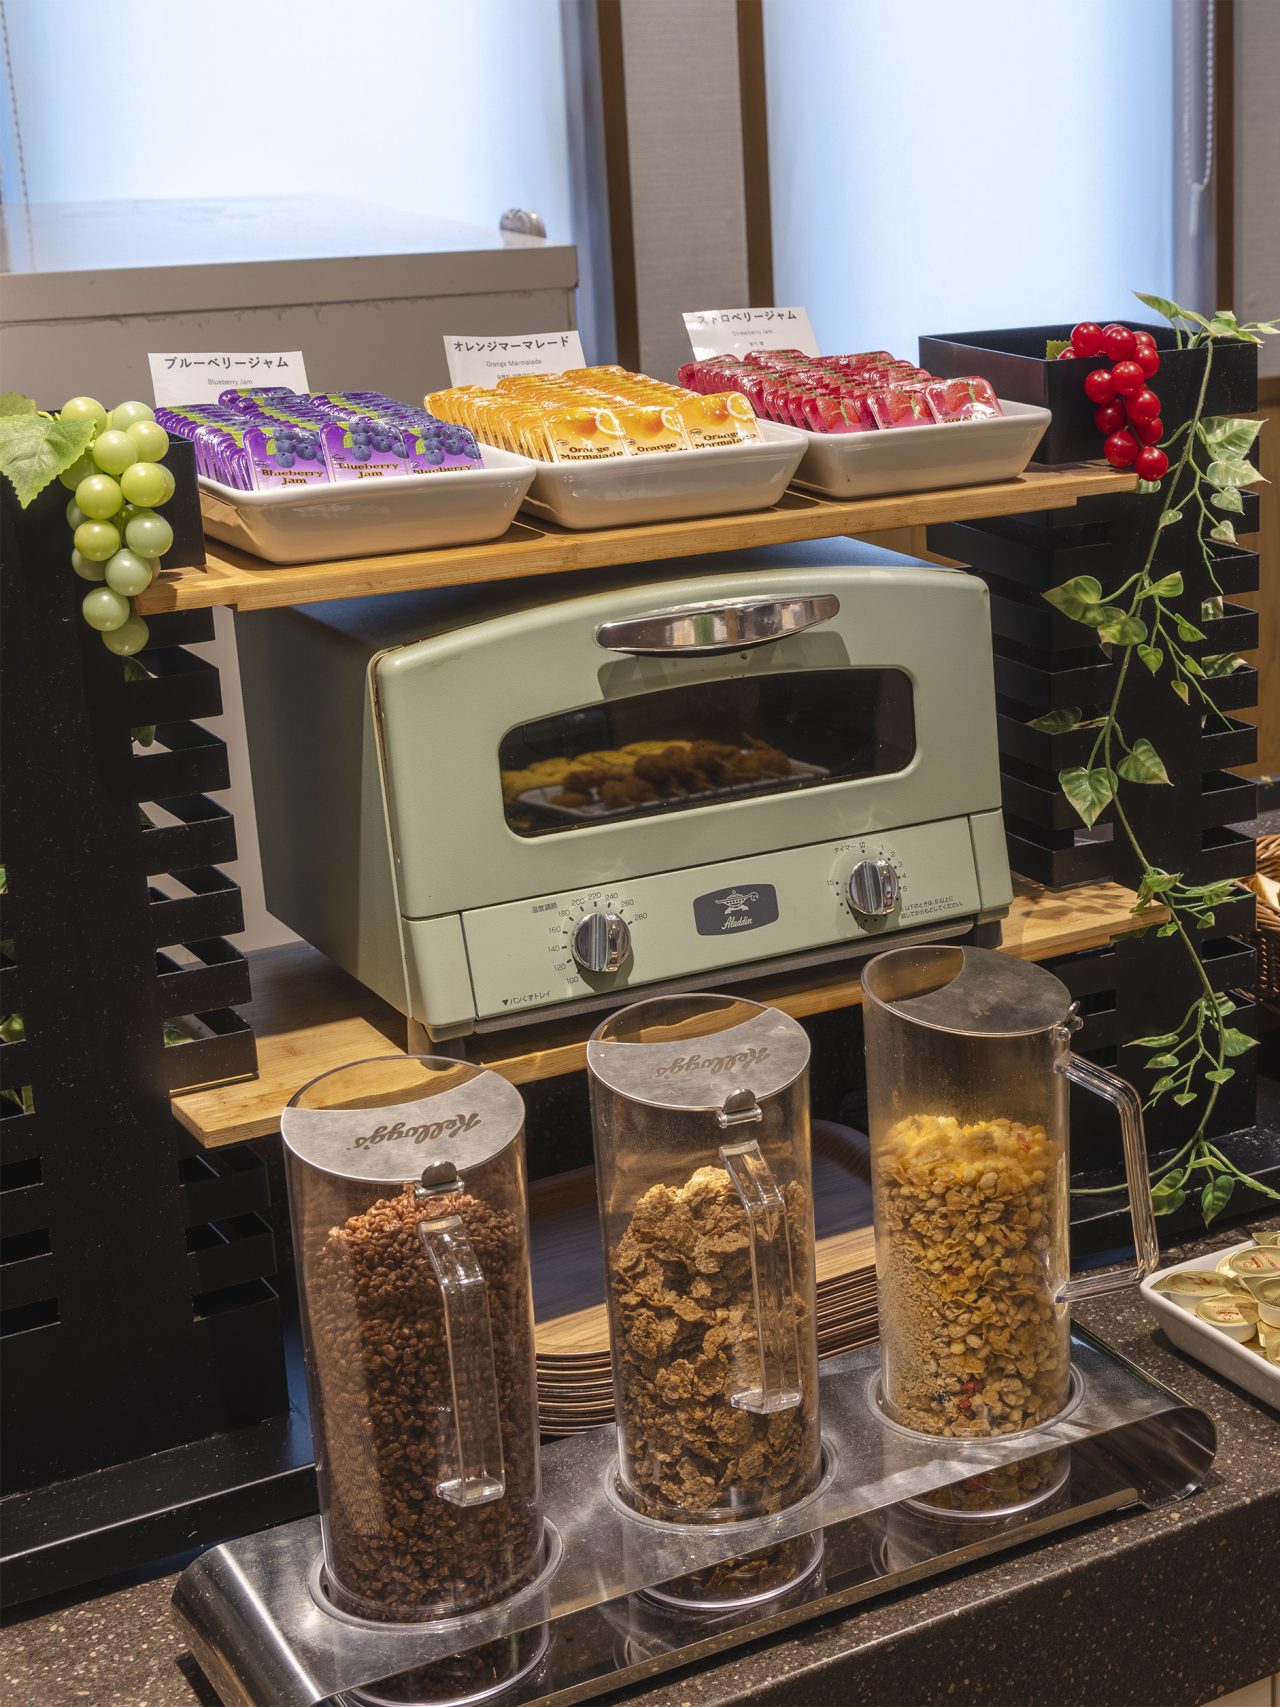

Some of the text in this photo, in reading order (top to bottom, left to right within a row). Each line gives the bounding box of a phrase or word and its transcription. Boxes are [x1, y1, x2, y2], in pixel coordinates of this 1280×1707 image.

[696, 310, 797, 325] ストロベリージャム
[453, 335, 569, 352] オレンジマーマレード
[164, 356, 289, 370] ブルーベリージャム
[485, 359, 542, 369] Orange Marmalade
[207, 378, 253, 386] Blueberry Jam
[569, 446, 609, 454] Orange
[636, 442, 678, 453] Orange
[261, 469, 324, 477] Blueberry
[358, 470, 384, 478] Jam
[281, 477, 307, 485] Jam
[833, 845, 857, 854] タイマー
[588, 892, 601, 901] 220
[605, 892, 619, 901] 240
[571, 899, 585, 907] 200
[620, 899, 634, 908] 260
[558, 909, 571, 917] 180
[634, 912, 648, 921] 280
[721, 915, 753, 930] Aladdin
[548, 925, 562, 934] 160
[547, 945, 561, 953] 140
[553, 964, 567, 972] 120
[566, 976, 579, 984] 100
[654, 1046, 771, 1080] Kellogg's
[353, 1112, 482, 1150] Kellogg's
